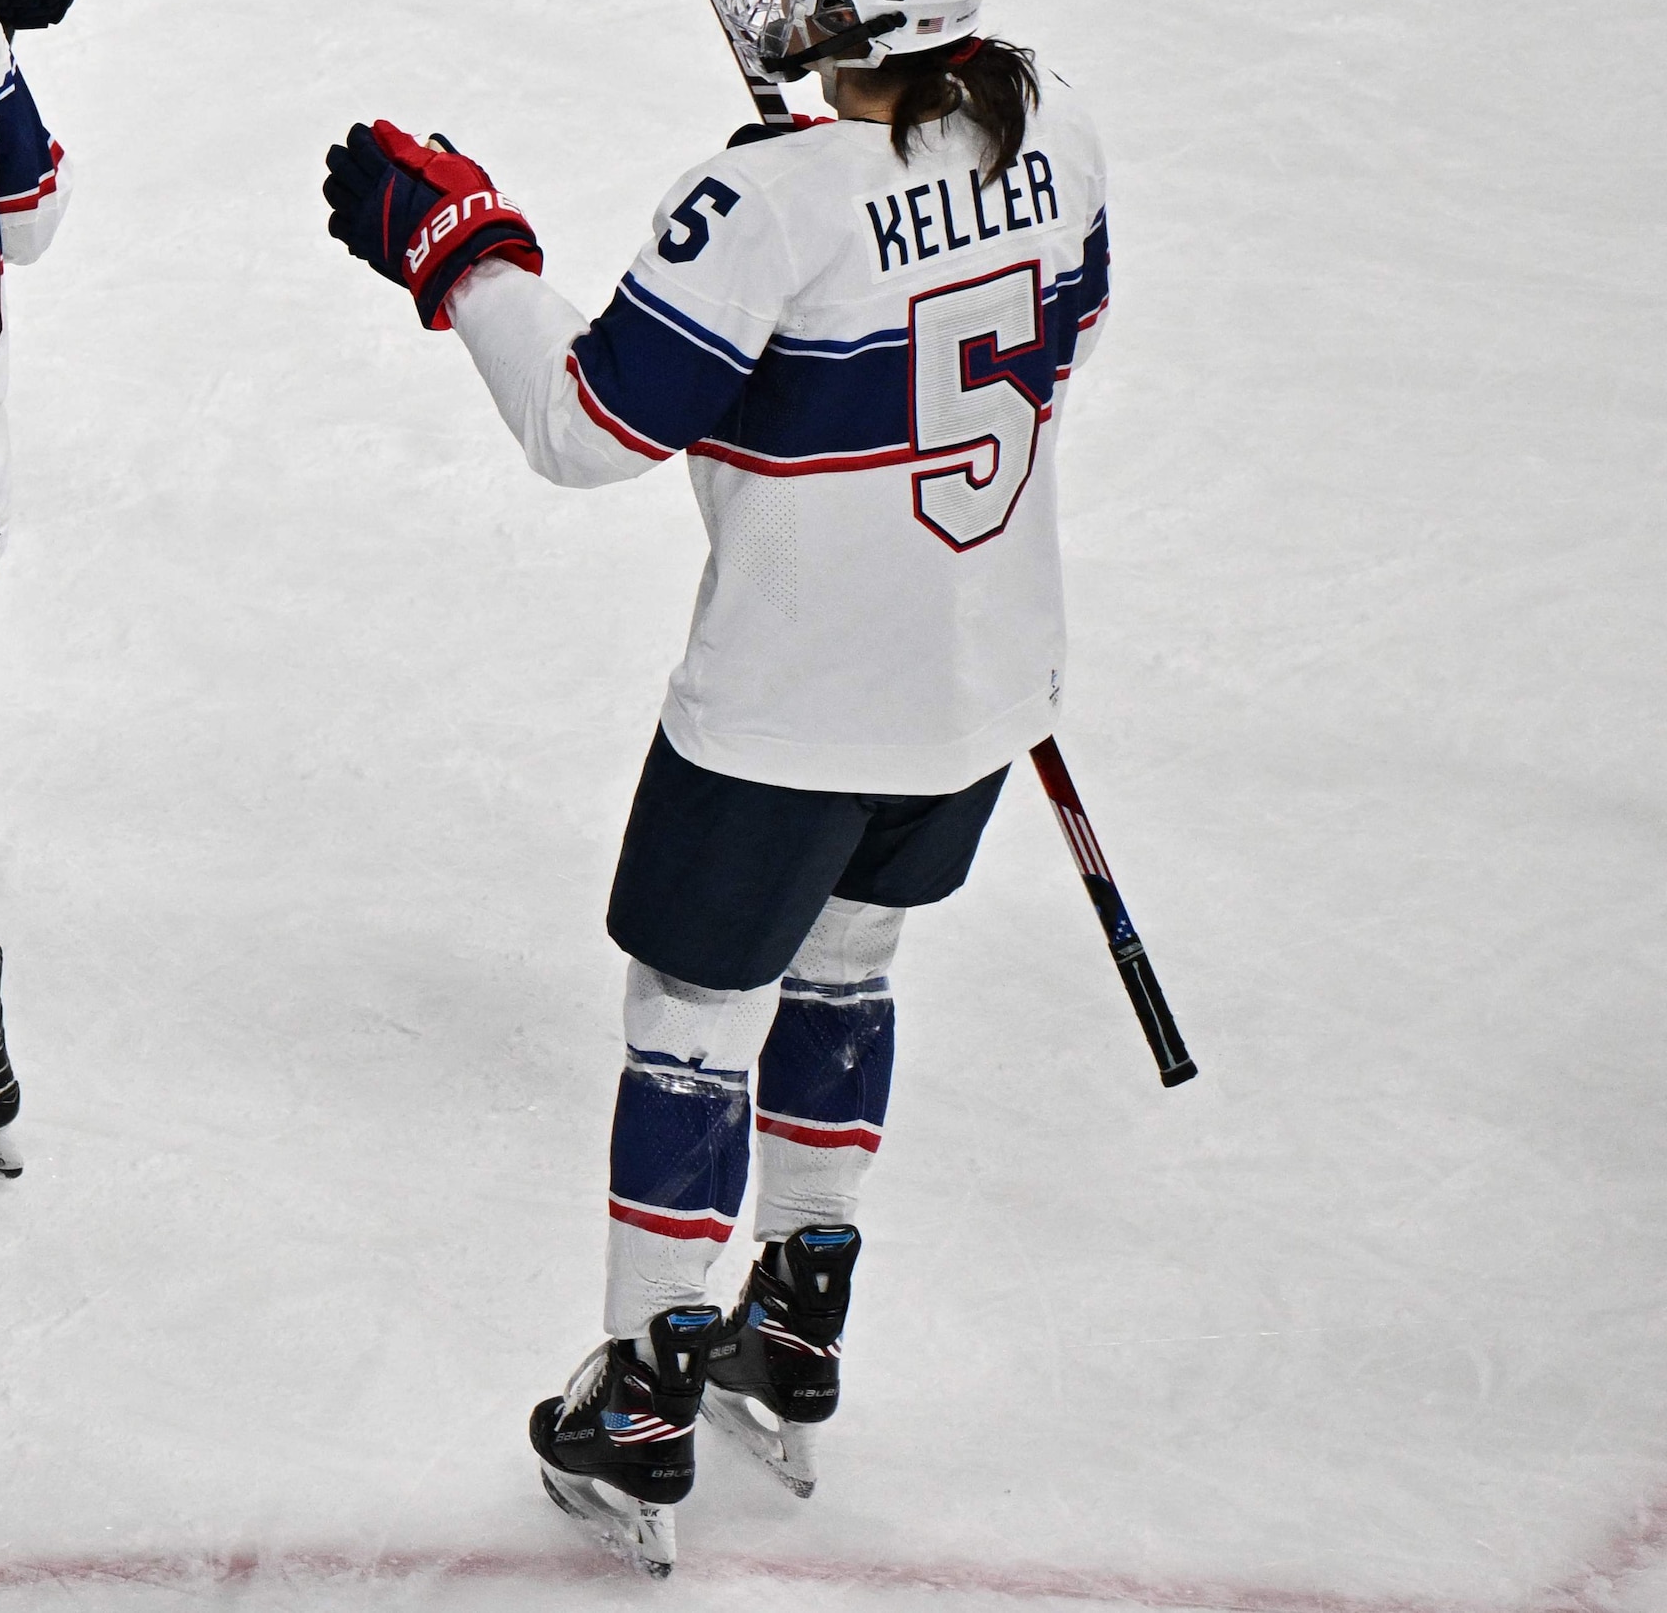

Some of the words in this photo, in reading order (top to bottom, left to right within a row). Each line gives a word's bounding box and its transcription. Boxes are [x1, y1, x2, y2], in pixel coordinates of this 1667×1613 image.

[657, 175, 742, 264] 5
[865, 150, 1059, 273] KELLER
[908, 259, 1044, 554] 5
